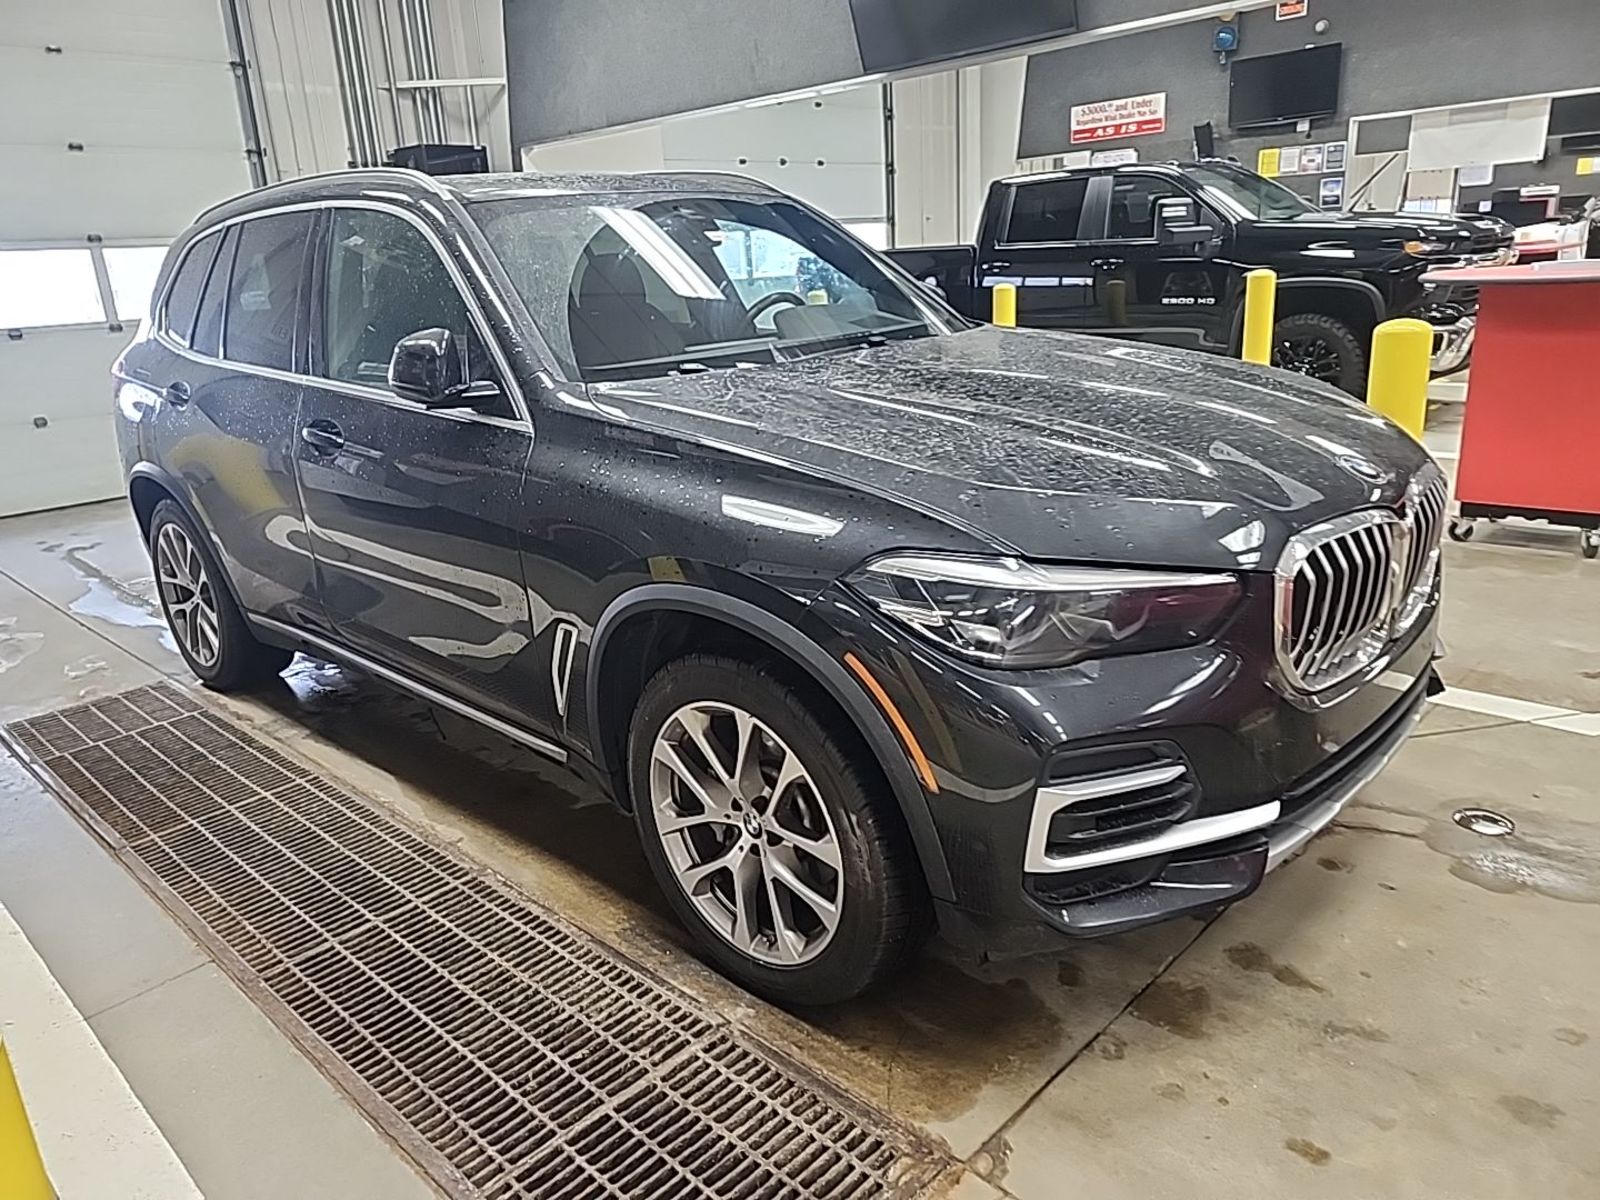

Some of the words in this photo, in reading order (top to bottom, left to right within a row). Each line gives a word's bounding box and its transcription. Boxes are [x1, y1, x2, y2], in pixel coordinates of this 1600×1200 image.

[1115, 101, 1128, 112] and
[1131, 99, 1153, 110] Under
[1093, 126, 1115, 137] AS
[1120, 123, 1138, 133] IS
[1197, 297, 1216, 305] HD
